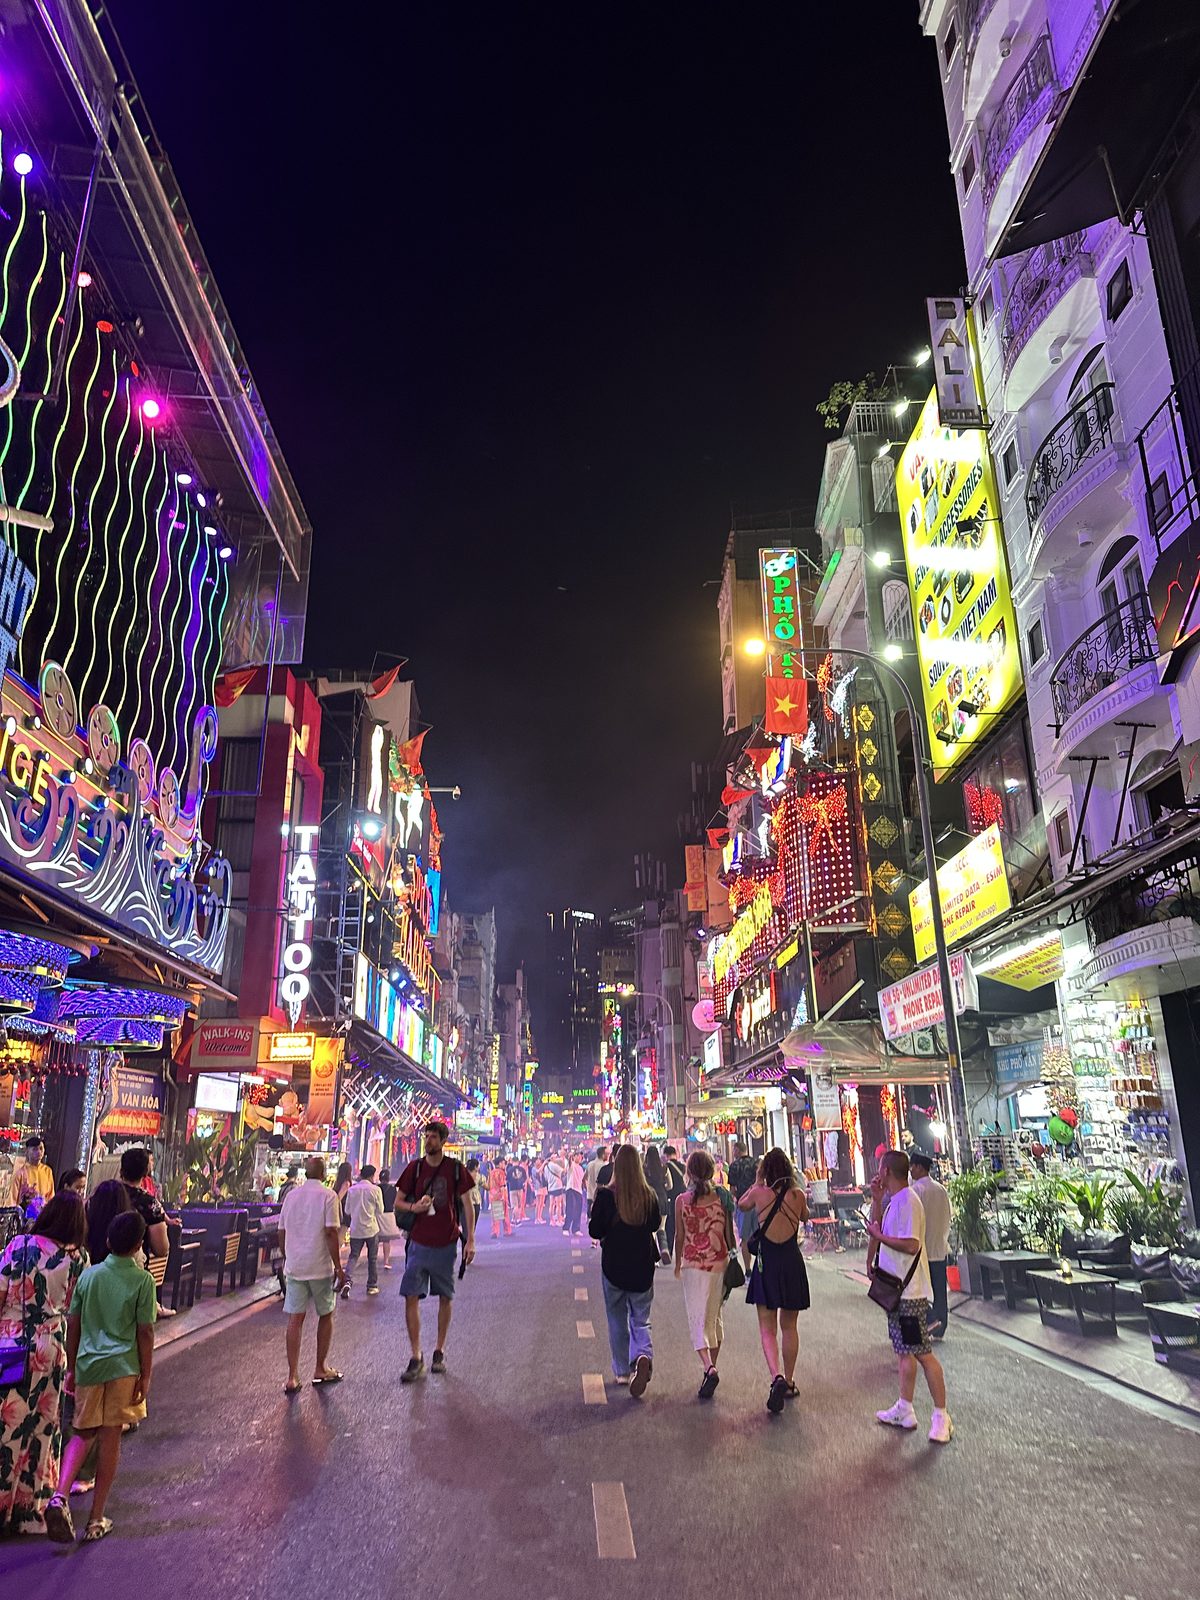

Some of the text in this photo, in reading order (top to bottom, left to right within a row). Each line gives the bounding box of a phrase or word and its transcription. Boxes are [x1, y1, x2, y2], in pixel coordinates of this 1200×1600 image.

[935, 301, 964, 404] BALI
[940, 457, 983, 548] ACCESSORIES
[764, 553, 796, 578] 86
[960, 606, 977, 642] VIET
[976, 576, 998, 620] NAM
[965, 883, 981, 898] DATA
[986, 865, 1003, 884] ESIM
[281, 825, 319, 1002] TATTOO
[955, 900, 977, 920] REPAIR
[881, 991, 892, 1009] SIM
[902, 971, 932, 1000] UNLIMITED
[902, 998, 923, 1020] PHONE
[202, 1027, 252, 1042] WALK-INS
[204, 1041, 247, 1053] Welcome
